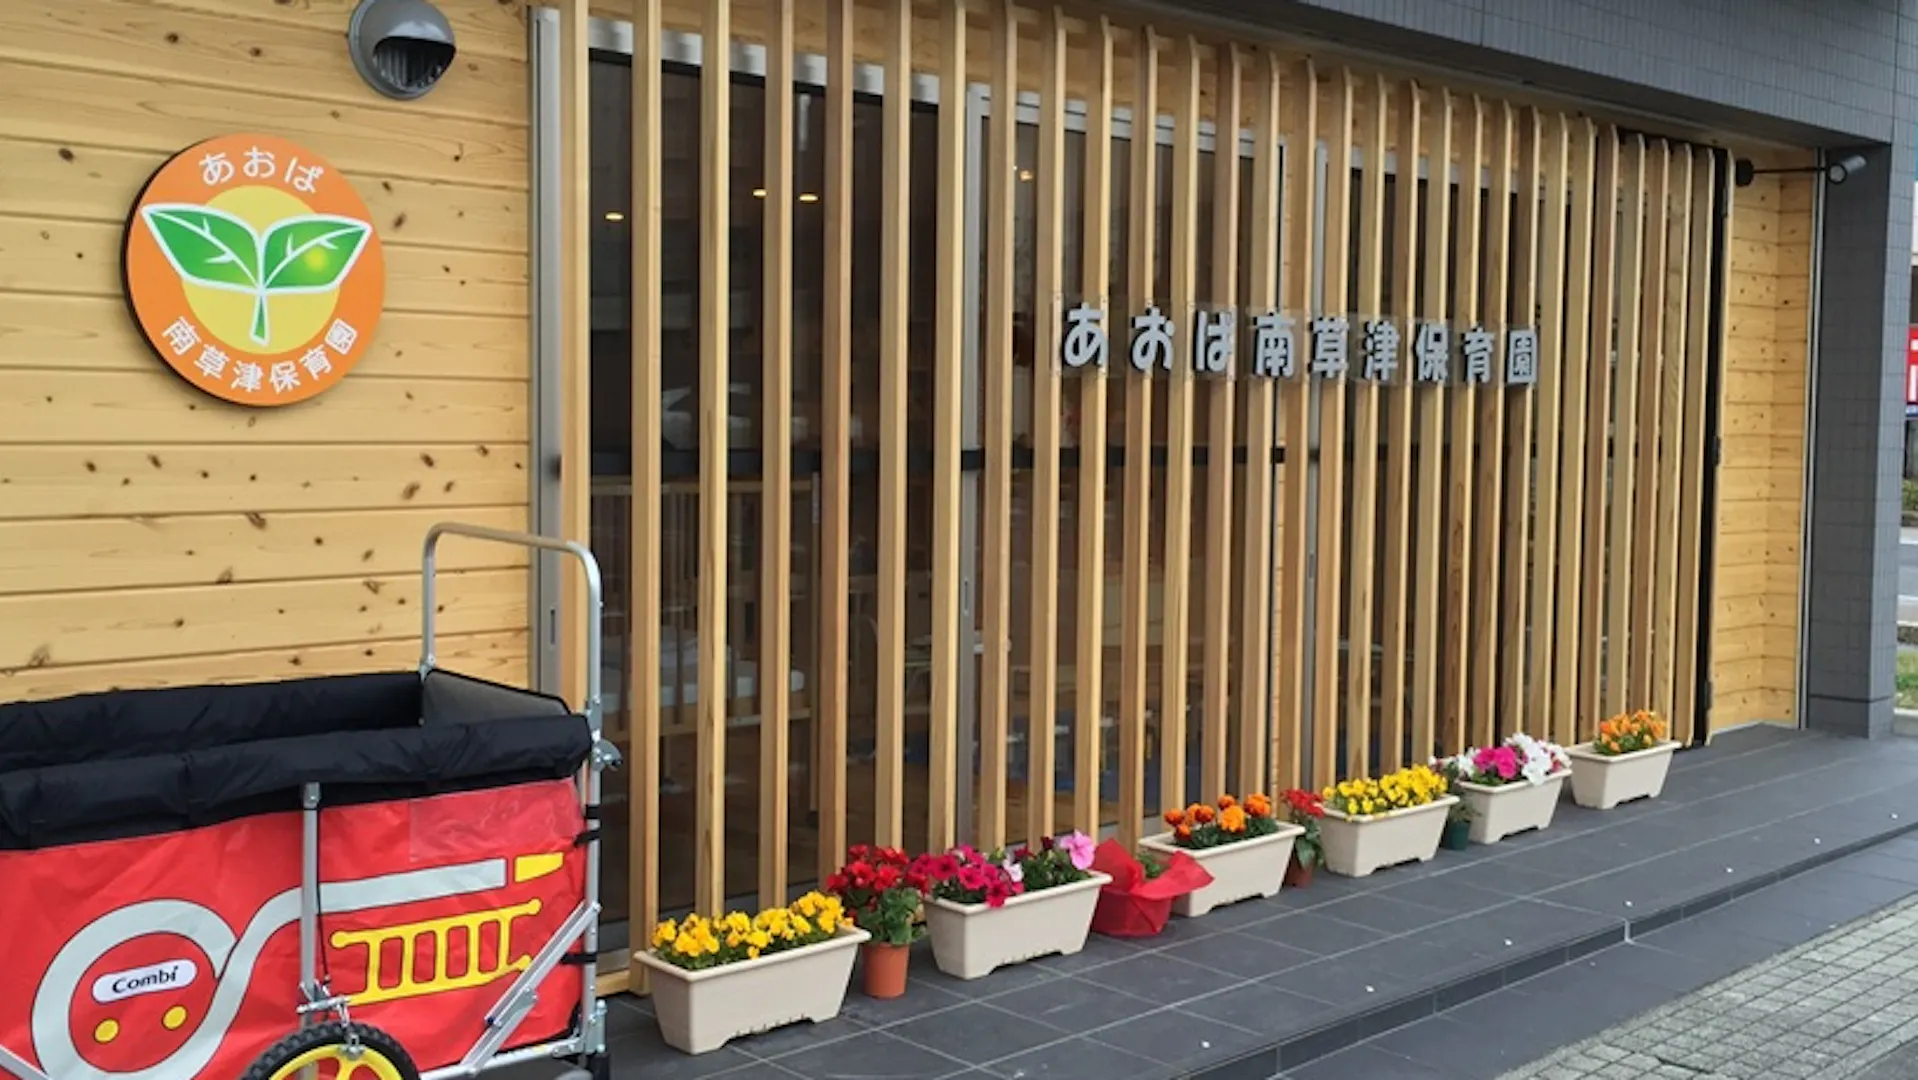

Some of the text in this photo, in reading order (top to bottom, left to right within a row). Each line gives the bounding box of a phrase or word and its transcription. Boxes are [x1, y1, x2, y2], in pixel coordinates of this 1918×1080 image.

[199, 146, 324, 193] あおば
[162, 316, 357, 393] 南草津保育園
[1063, 302, 1538, 384] あおば南草津保育園
[112, 965, 179, 993] Combi
